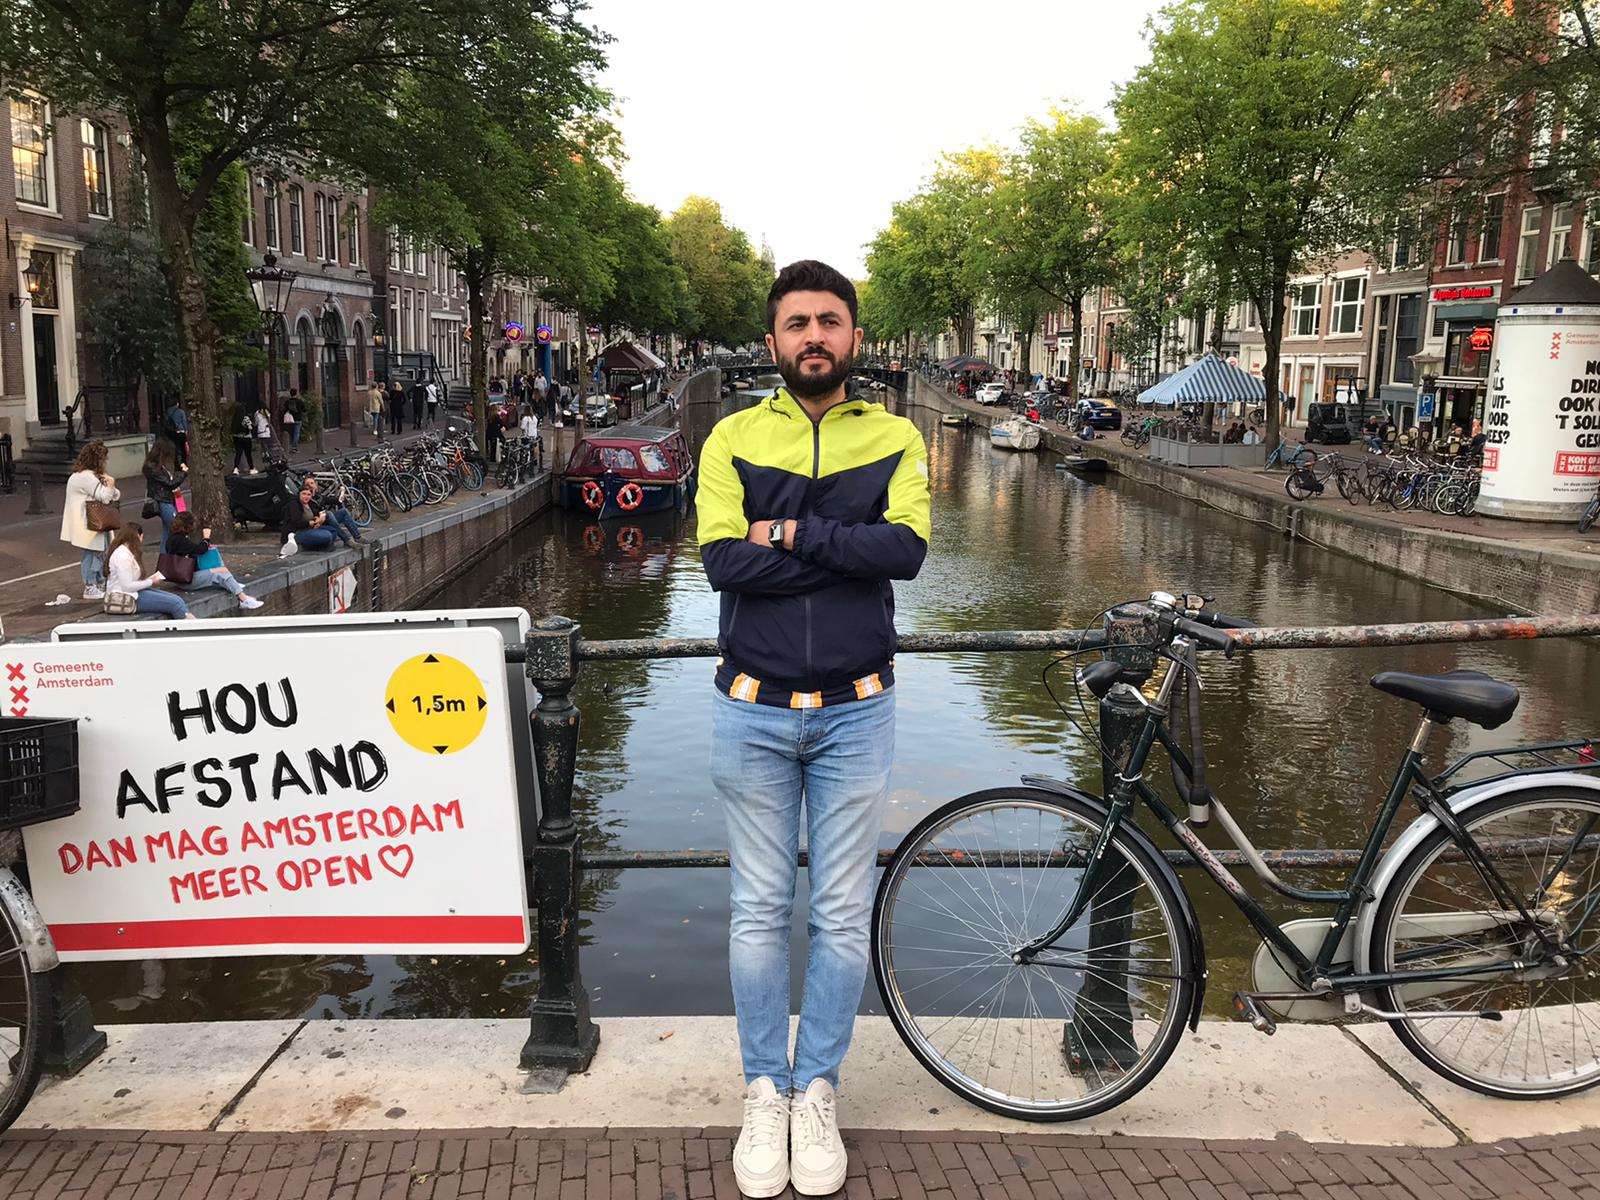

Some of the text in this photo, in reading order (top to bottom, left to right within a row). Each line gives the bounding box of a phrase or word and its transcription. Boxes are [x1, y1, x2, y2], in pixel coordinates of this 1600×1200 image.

[1559, 397, 1595, 412] OOK
[33, 662, 104, 674] Gemeente
[36, 675, 114, 689] Amsterdam
[166, 677, 298, 741] HOU
[412, 695, 466, 715] 1,5m
[117, 740, 389, 819] AFSTAND
[59, 799, 465, 874] DAN MAG AMSTERDAM
[169, 854, 373, 904] MEER OPEN
